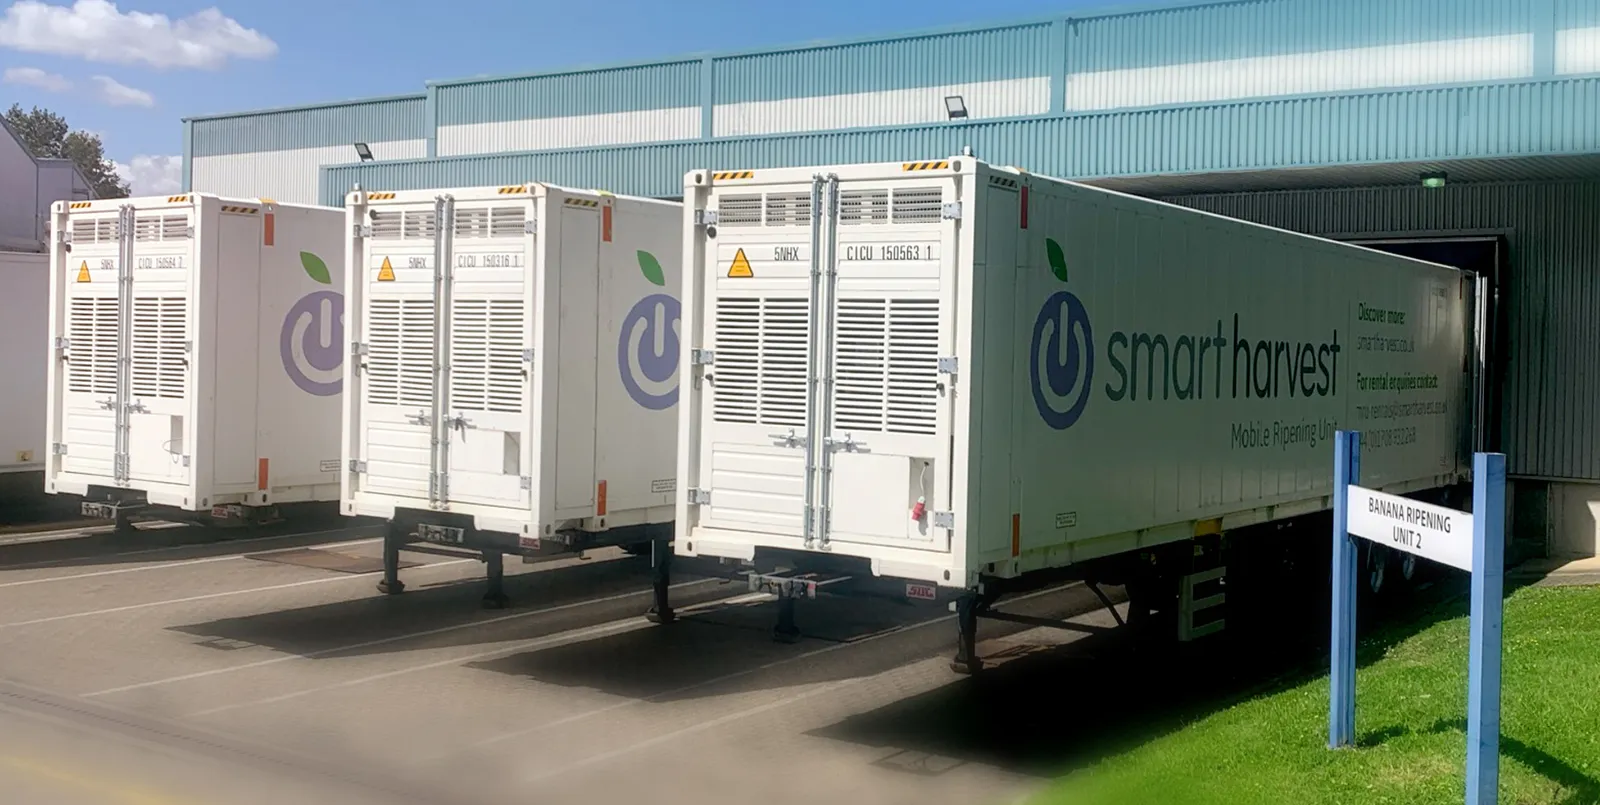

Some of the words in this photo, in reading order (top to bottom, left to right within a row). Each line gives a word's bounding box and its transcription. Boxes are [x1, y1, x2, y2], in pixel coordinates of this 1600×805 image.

[482, 254, 510, 268] 150316
[847, 246, 873, 260] CICU
[881, 245, 920, 260] 150563
[926, 245, 932, 260] 1
[1358, 302, 1386, 323] Discover
[1231, 421, 1270, 449] Mobile
[1273, 417, 1316, 451] Ripening
[1368, 497, 1405, 522] BANANA
[1406, 506, 1451, 534] RIPENING
[1393, 525, 1415, 547] UNIT
[1416, 533, 1422, 549] 2
